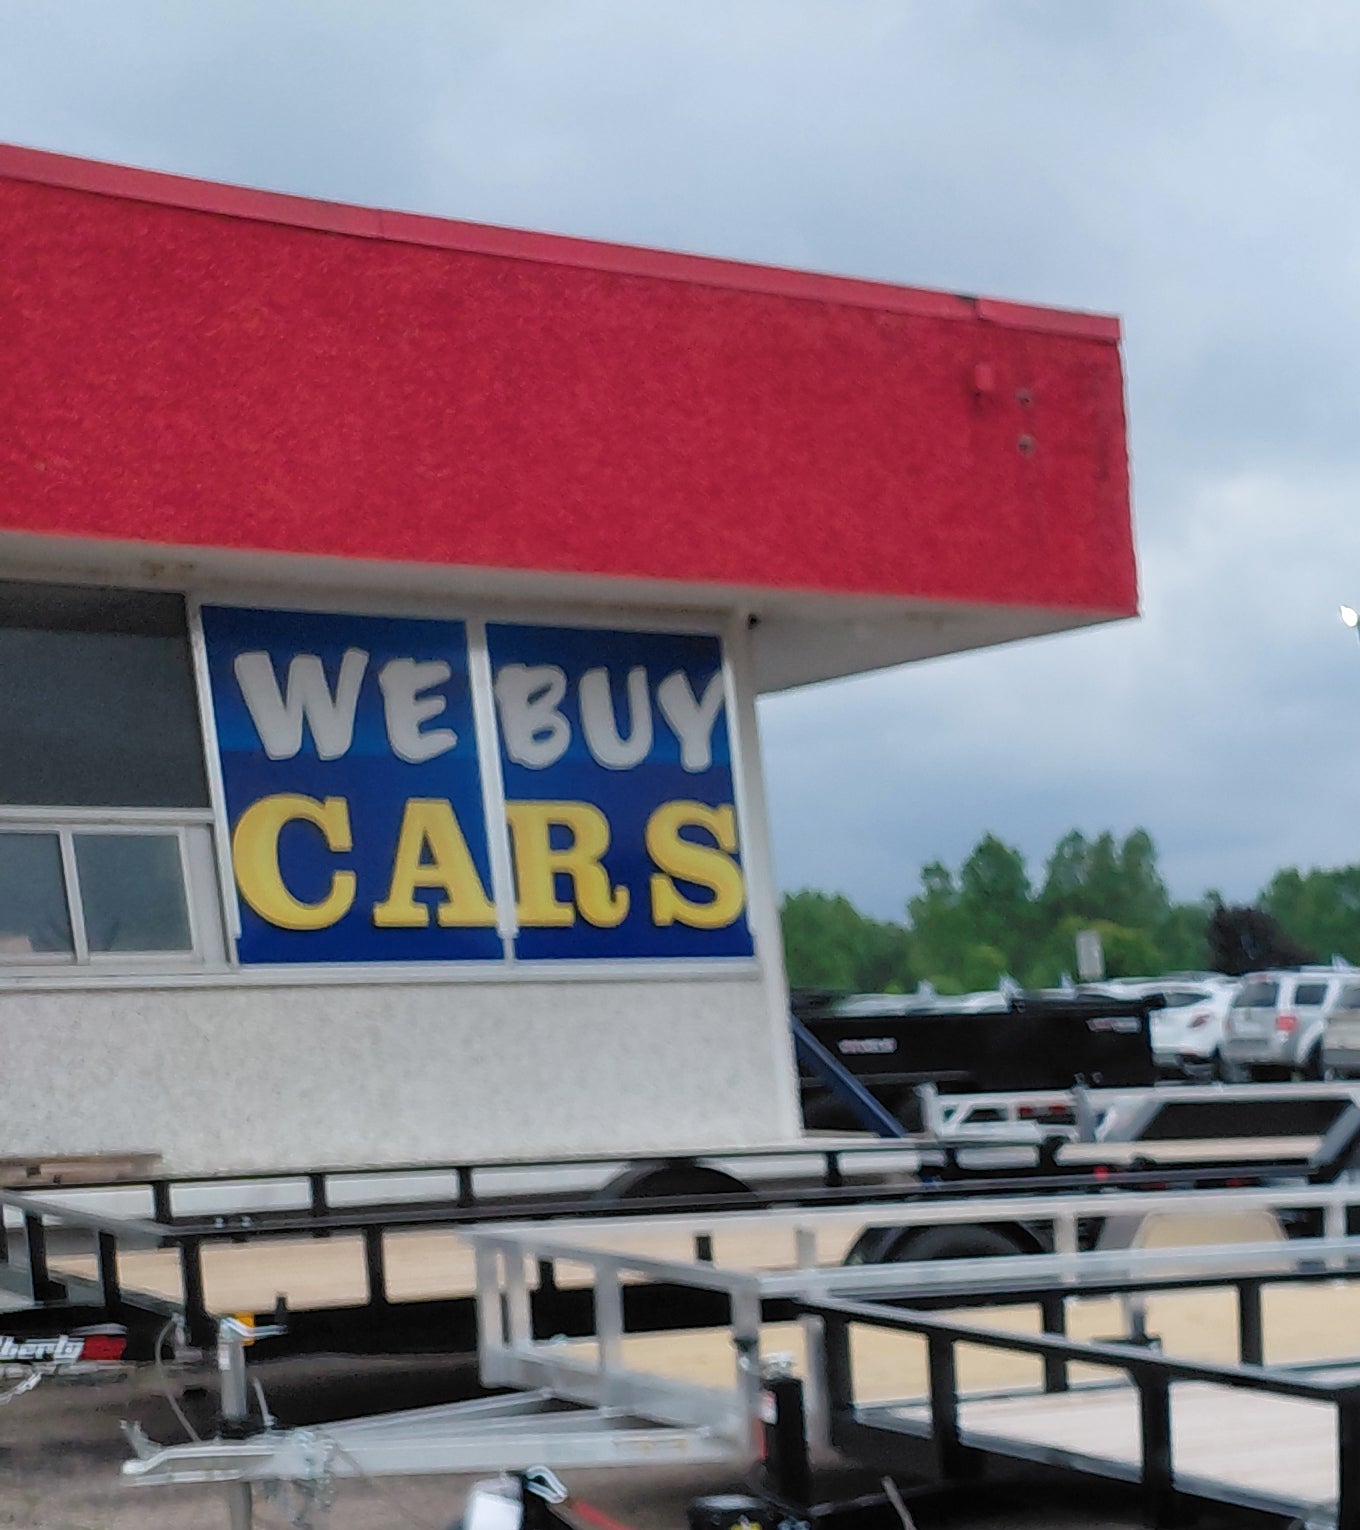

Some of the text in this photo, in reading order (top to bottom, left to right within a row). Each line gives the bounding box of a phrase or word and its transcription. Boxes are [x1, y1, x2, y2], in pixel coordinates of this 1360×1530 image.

[234, 647, 726, 773] WE BUY
[233, 793, 745, 930] CARS
